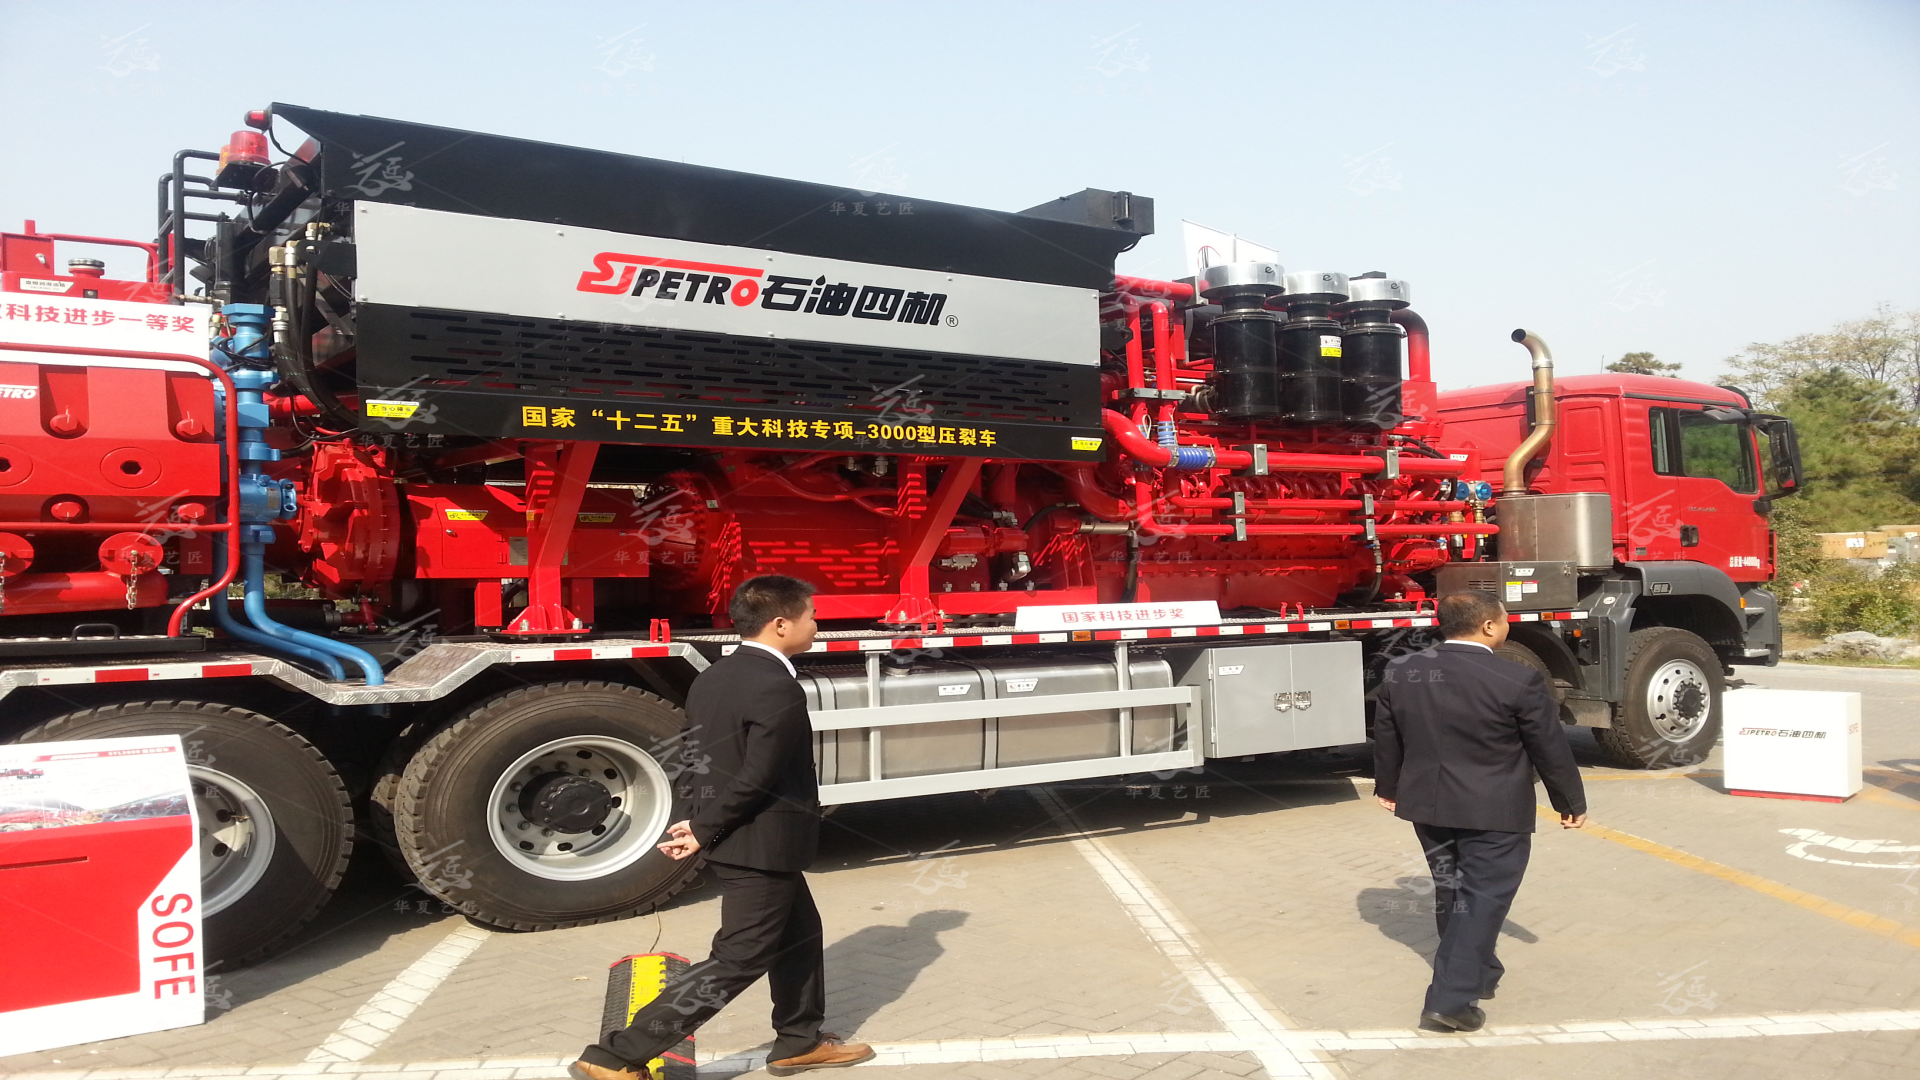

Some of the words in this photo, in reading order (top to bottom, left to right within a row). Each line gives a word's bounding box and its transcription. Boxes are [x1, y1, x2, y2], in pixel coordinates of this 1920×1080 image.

[0, 303, 195, 333] 科技进步一等奖
[1061, 608, 1185, 623] 国家科技进步奖
[151, 893, 195, 1000] SOFE
